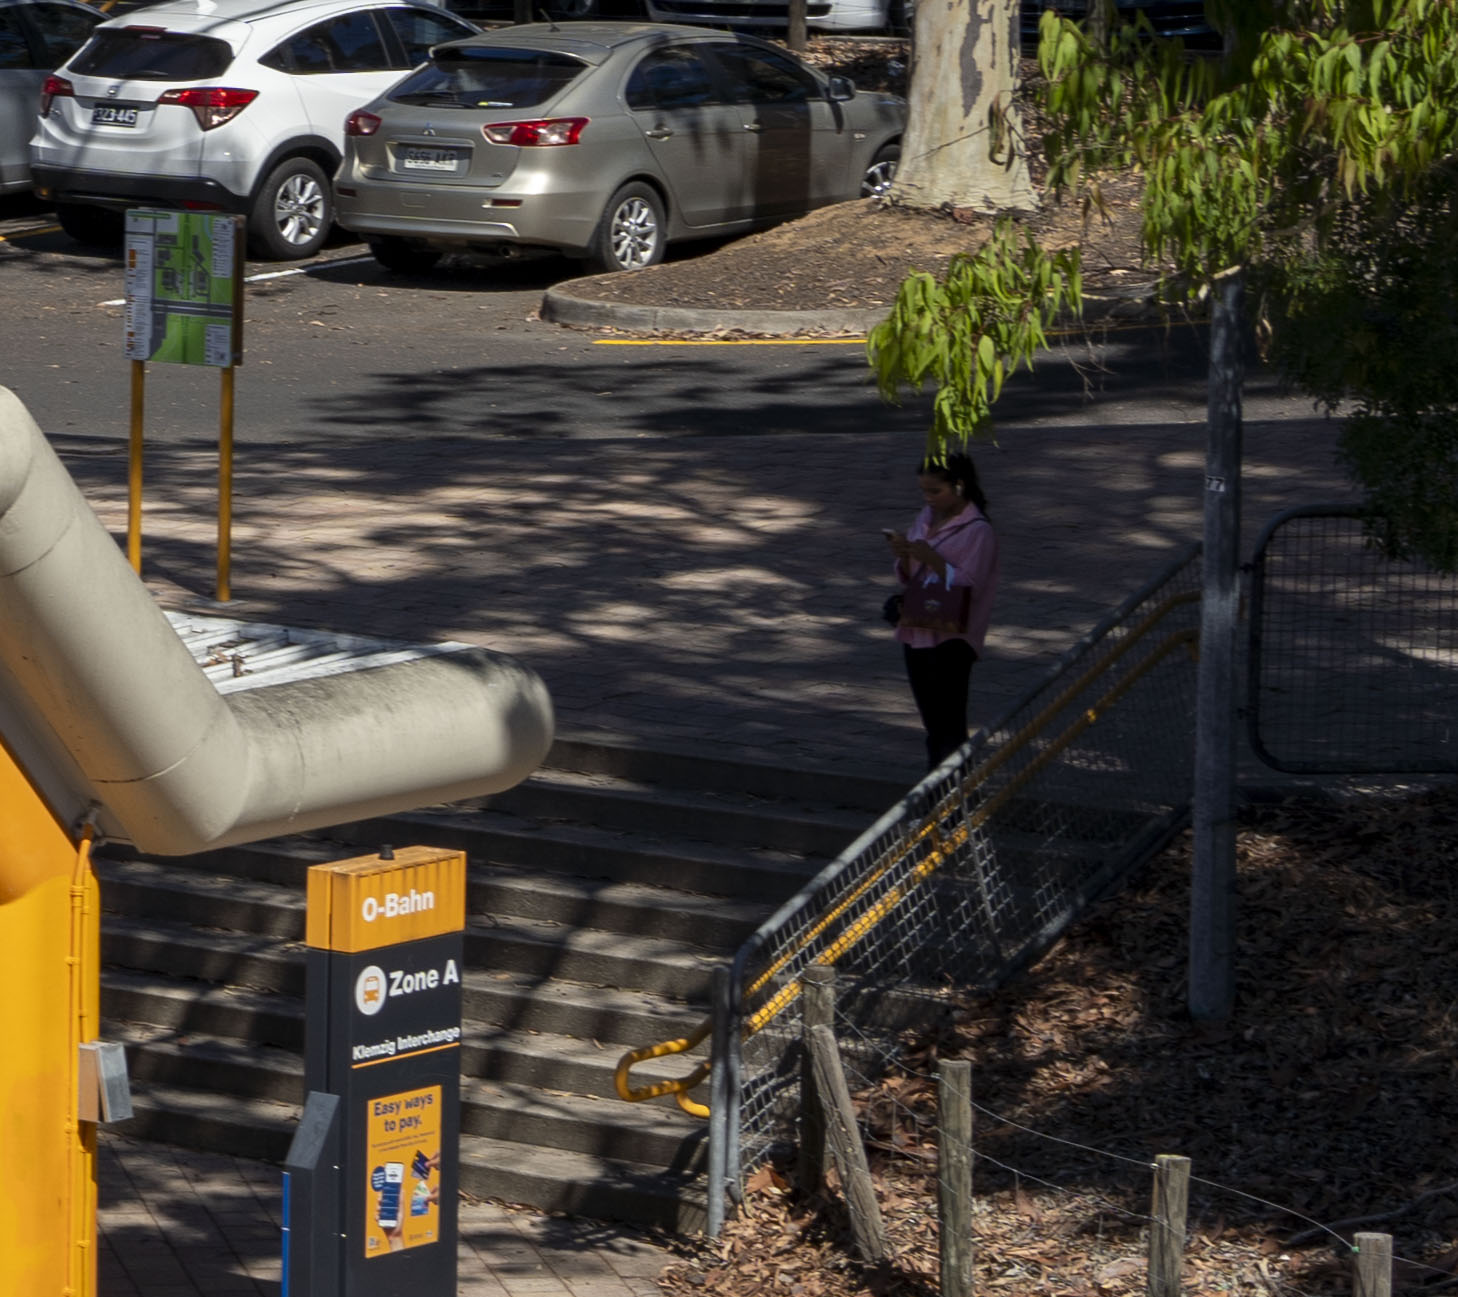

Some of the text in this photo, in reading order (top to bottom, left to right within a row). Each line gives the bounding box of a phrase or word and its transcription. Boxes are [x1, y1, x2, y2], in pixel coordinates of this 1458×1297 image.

[362, 889, 435, 923] O-Bahn
[389, 959, 459, 997] Zone A
[352, 1026, 460, 1060] Klemzig Interchange
[374, 1093, 433, 1117] Easy ways
[384, 1119, 396, 1132] to
